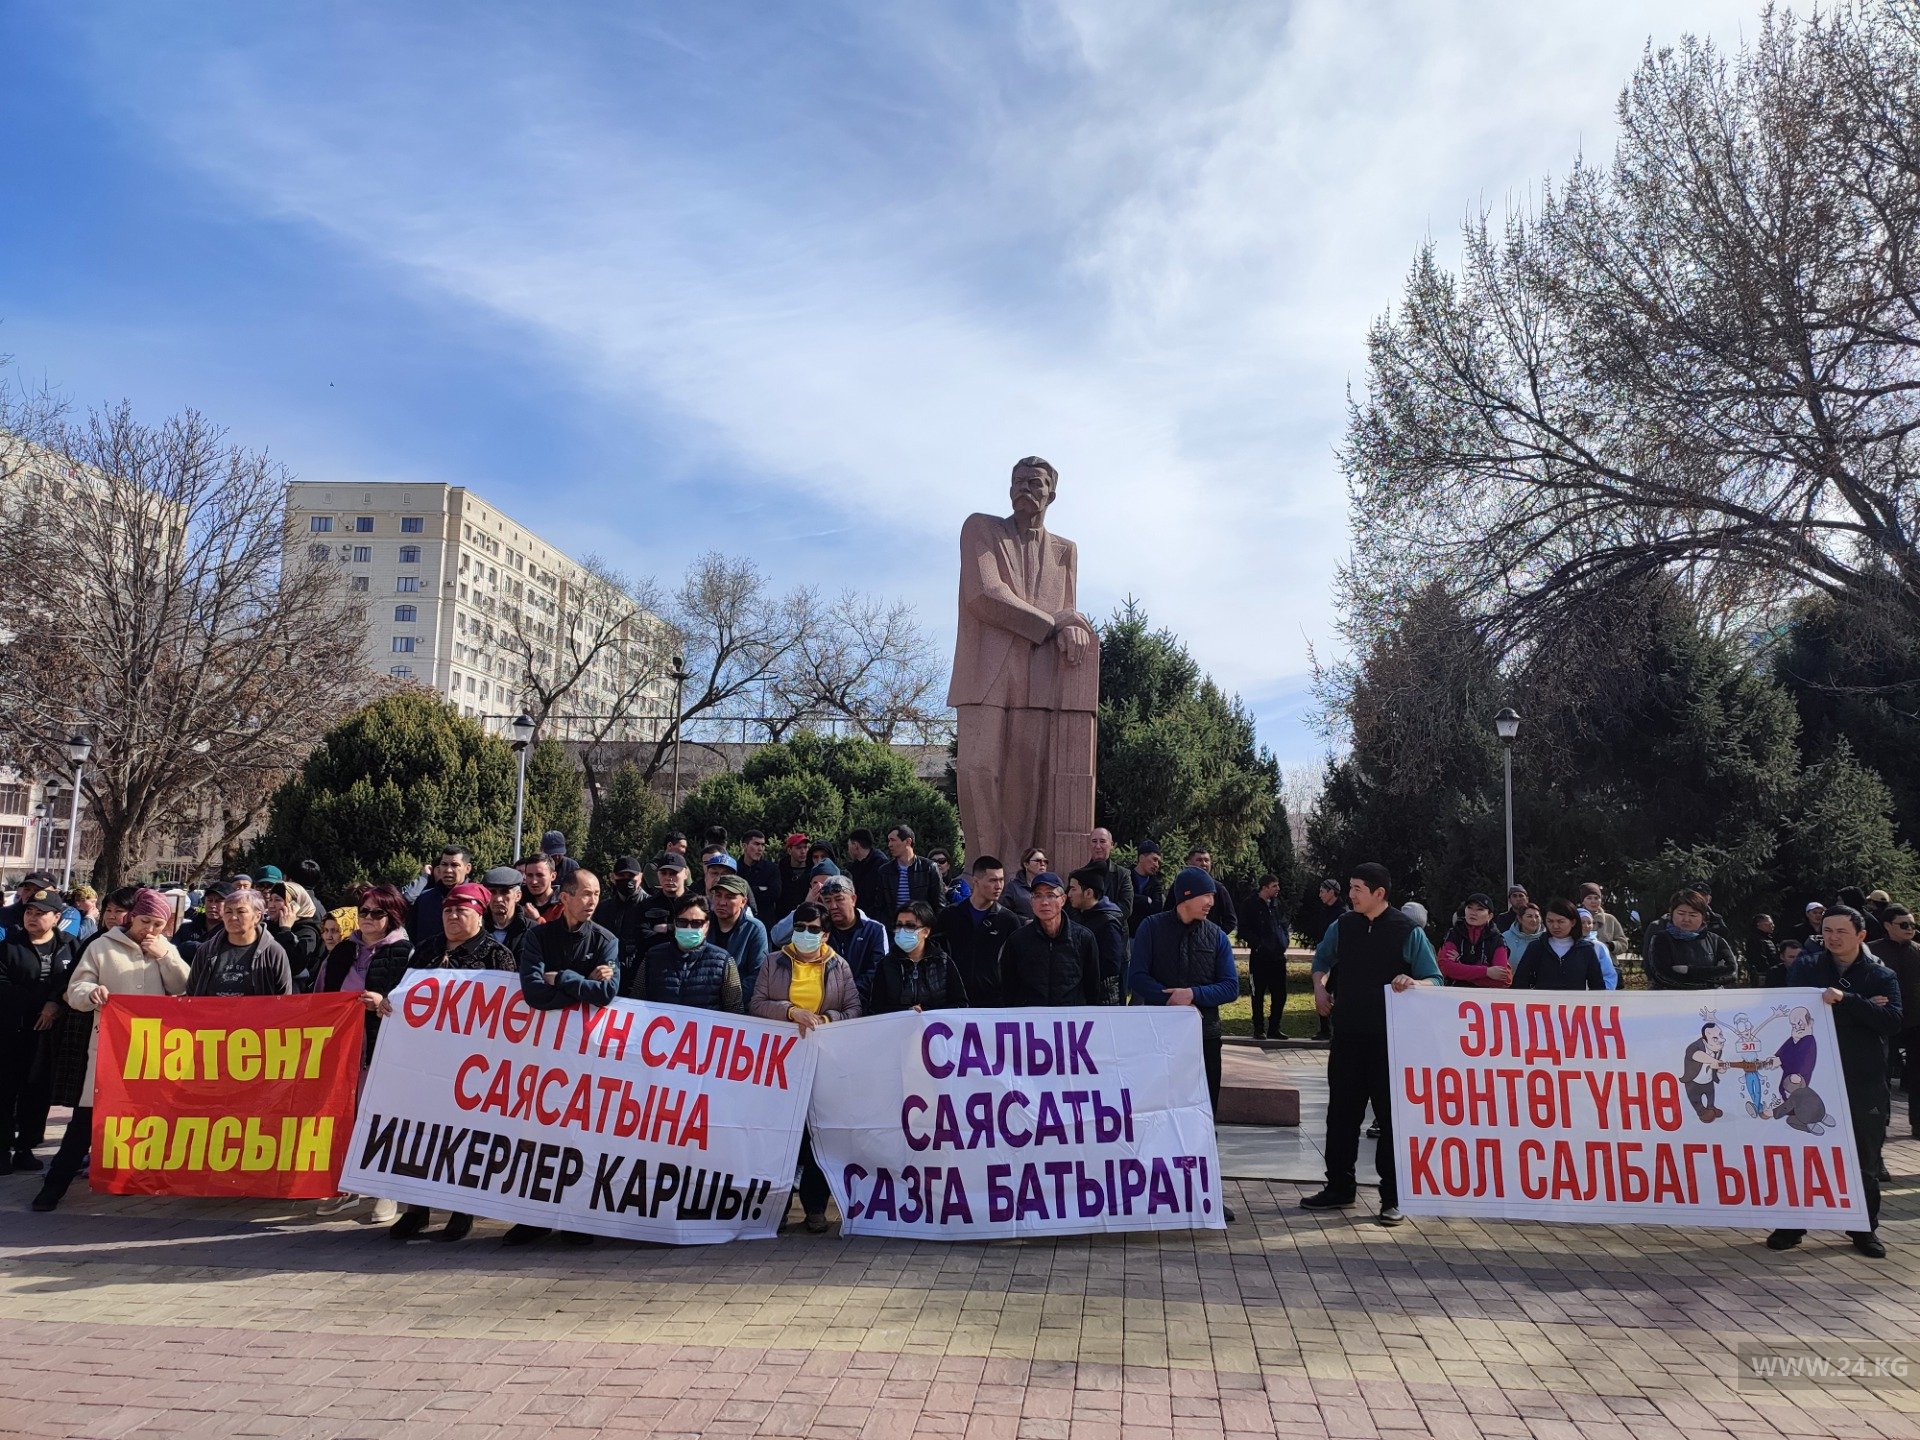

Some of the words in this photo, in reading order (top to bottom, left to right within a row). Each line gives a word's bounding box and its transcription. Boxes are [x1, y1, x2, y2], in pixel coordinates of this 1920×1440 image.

[123, 1018, 335, 1081] Патент
[641, 1015, 798, 1090] САЛЫК
[921, 1021, 1099, 1079] САЛЫК
[1458, 1001, 1626, 1066] ЭЛДИН
[1741, 1042, 1756, 1051] ЭЛ
[454, 1053, 709, 1150] САЯСАТЫНА
[901, 1088, 1135, 1151] САЯСАТЫ
[1404, 1067, 1683, 1131] ЧӨНТӨГҮНӨ
[102, 1116, 335, 1172] калсын
[359, 1114, 584, 1204] ИШКЕРЛЕР
[589, 1152, 771, 1221] КАРШЫ!
[1408, 1136, 1505, 1197] КОЛ
[1518, 1139, 1851, 1209] САЛБАГЫЛА!
[843, 1163, 974, 1225] САЗГА
[987, 1155, 1211, 1223] БАТЫРАТ!
